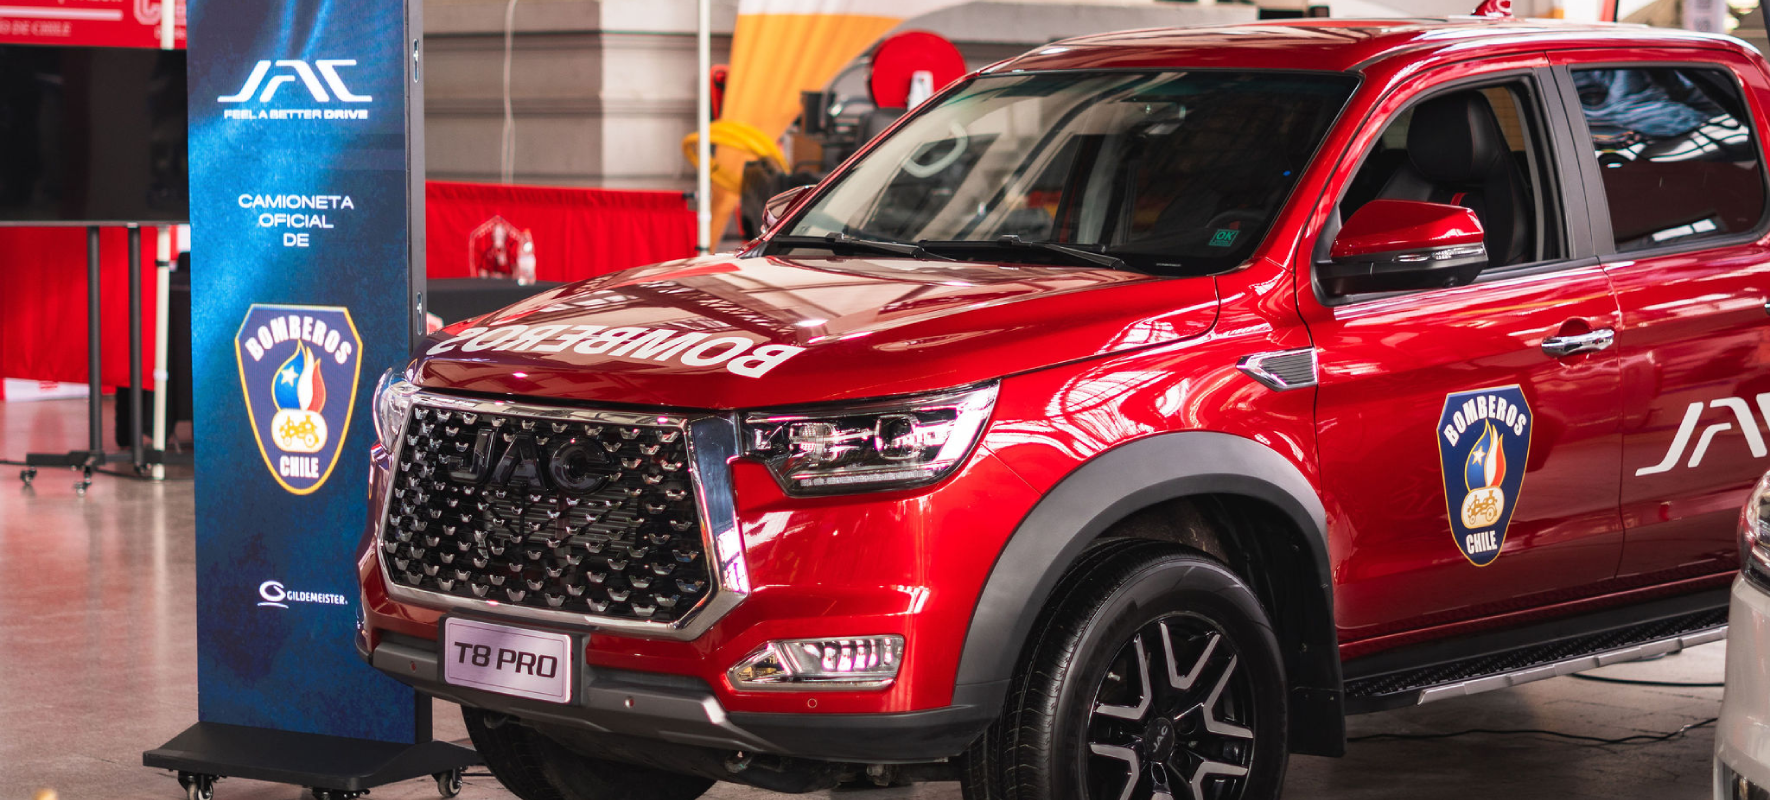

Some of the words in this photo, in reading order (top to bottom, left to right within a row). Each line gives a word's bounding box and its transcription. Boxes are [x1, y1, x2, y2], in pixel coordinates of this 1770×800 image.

[217, 59, 373, 102] JAC
[224, 109, 257, 120] FEEL
[258, 109, 269, 120] A
[269, 109, 322, 120] BETTER
[324, 109, 369, 120] DRIVE
[238, 193, 355, 210] CAMIONETA
[258, 213, 335, 229] OFICIAL
[283, 232, 310, 248] DE
[1216, 231, 1236, 241] OK
[244, 315, 352, 364] BOMBEROS
[1443, 394, 1528, 447] BOMBEROS
[1635, 391, 1770, 477] JA
[279, 455, 320, 478] CHILE
[448, 428, 614, 496] JAC
[1465, 530, 1498, 555] CHILE
[454, 641, 491, 667] T8
[496, 647, 558, 679] PRO
[1152, 725, 1169, 753] JAC
